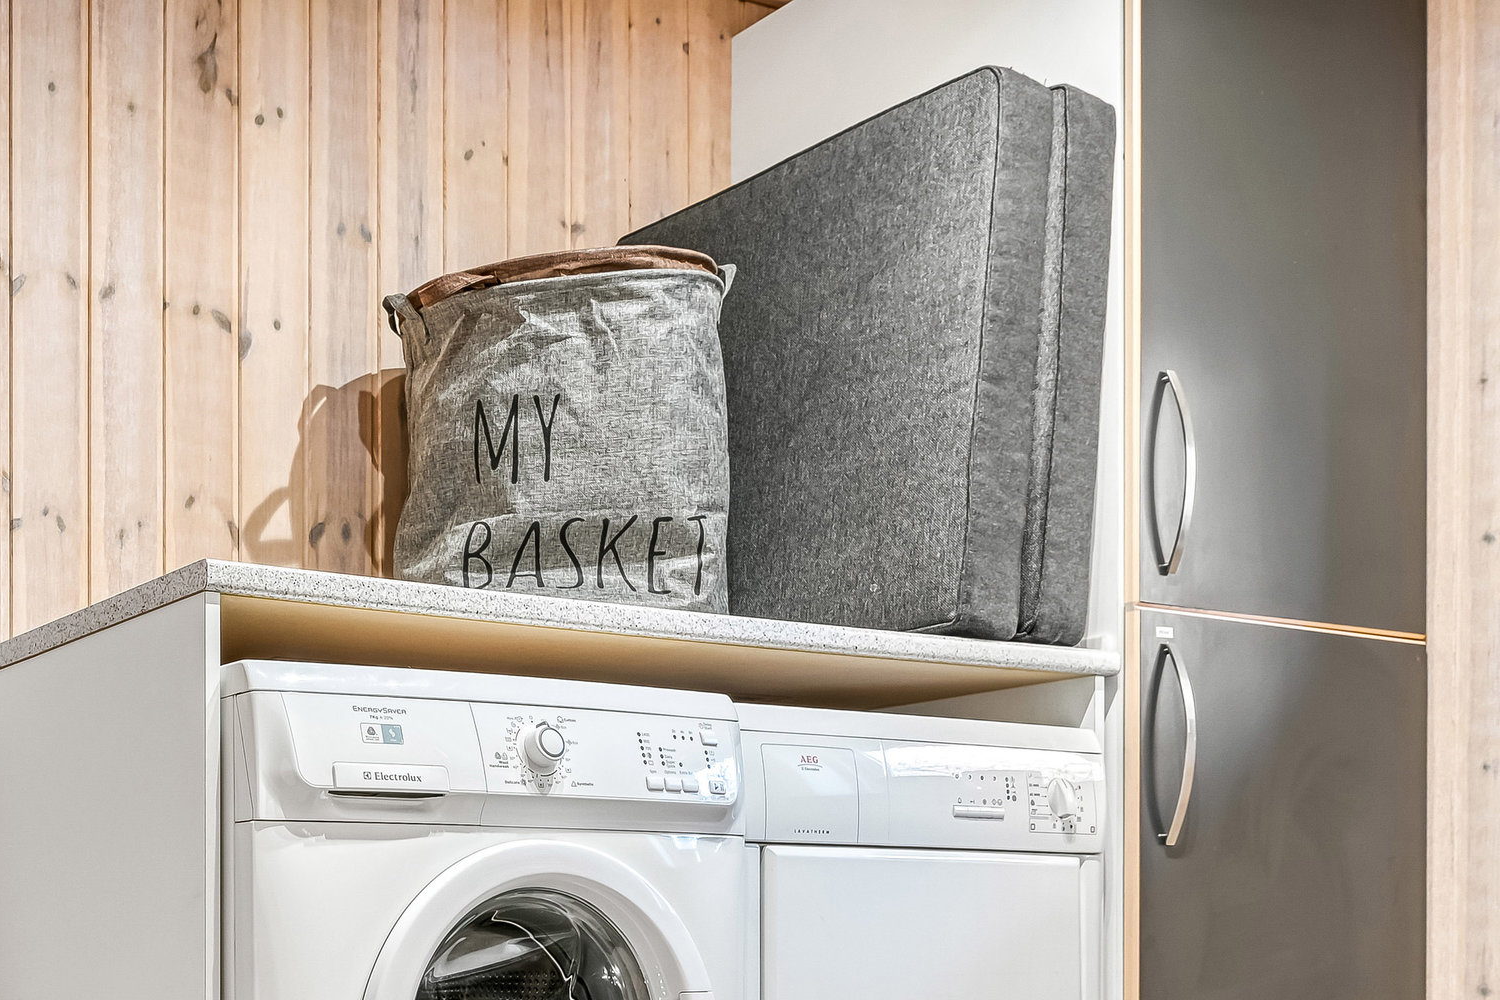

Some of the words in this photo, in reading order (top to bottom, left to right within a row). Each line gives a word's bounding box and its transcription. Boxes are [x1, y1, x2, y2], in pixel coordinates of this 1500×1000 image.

[473, 394, 561, 484] MY
[462, 514, 707, 595] BASKET
[374, 771, 422, 783] Electrolux
[800, 755, 819, 764] AEG
